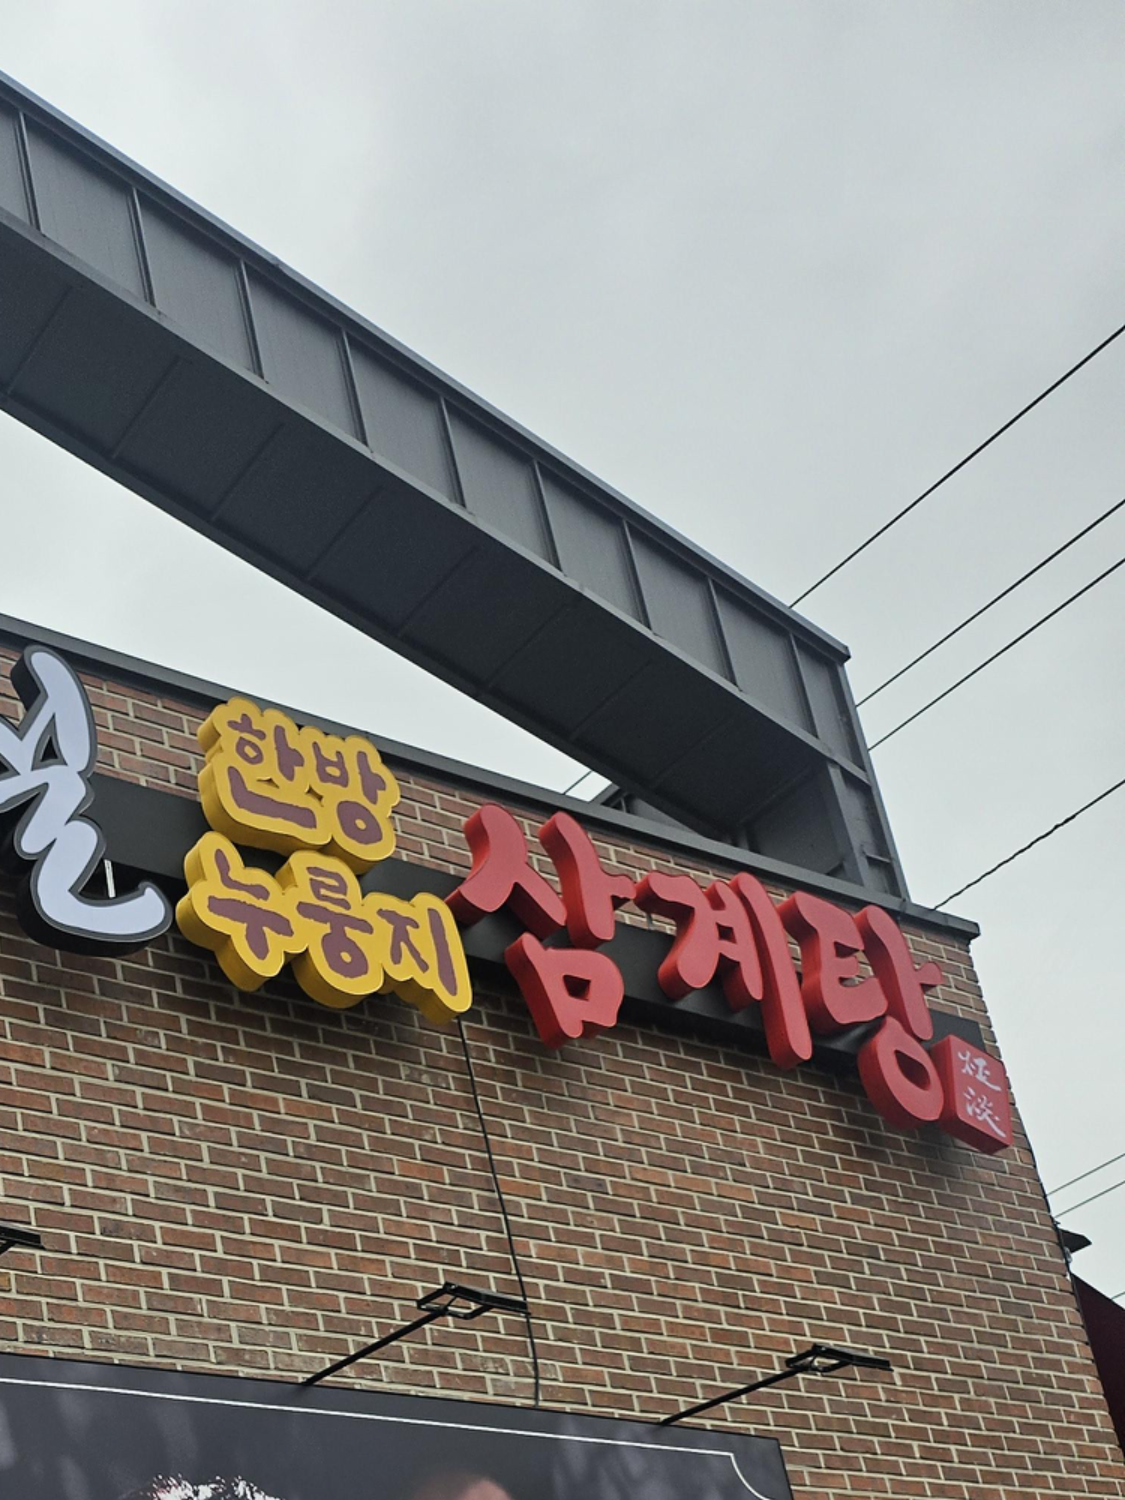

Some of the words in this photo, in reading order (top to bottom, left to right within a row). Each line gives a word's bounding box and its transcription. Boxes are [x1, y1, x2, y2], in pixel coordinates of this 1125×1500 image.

[223, 712, 388, 846] 한방
[203, 845, 460, 998] 누룽지
[447, 802, 944, 1122] 삼계탕
